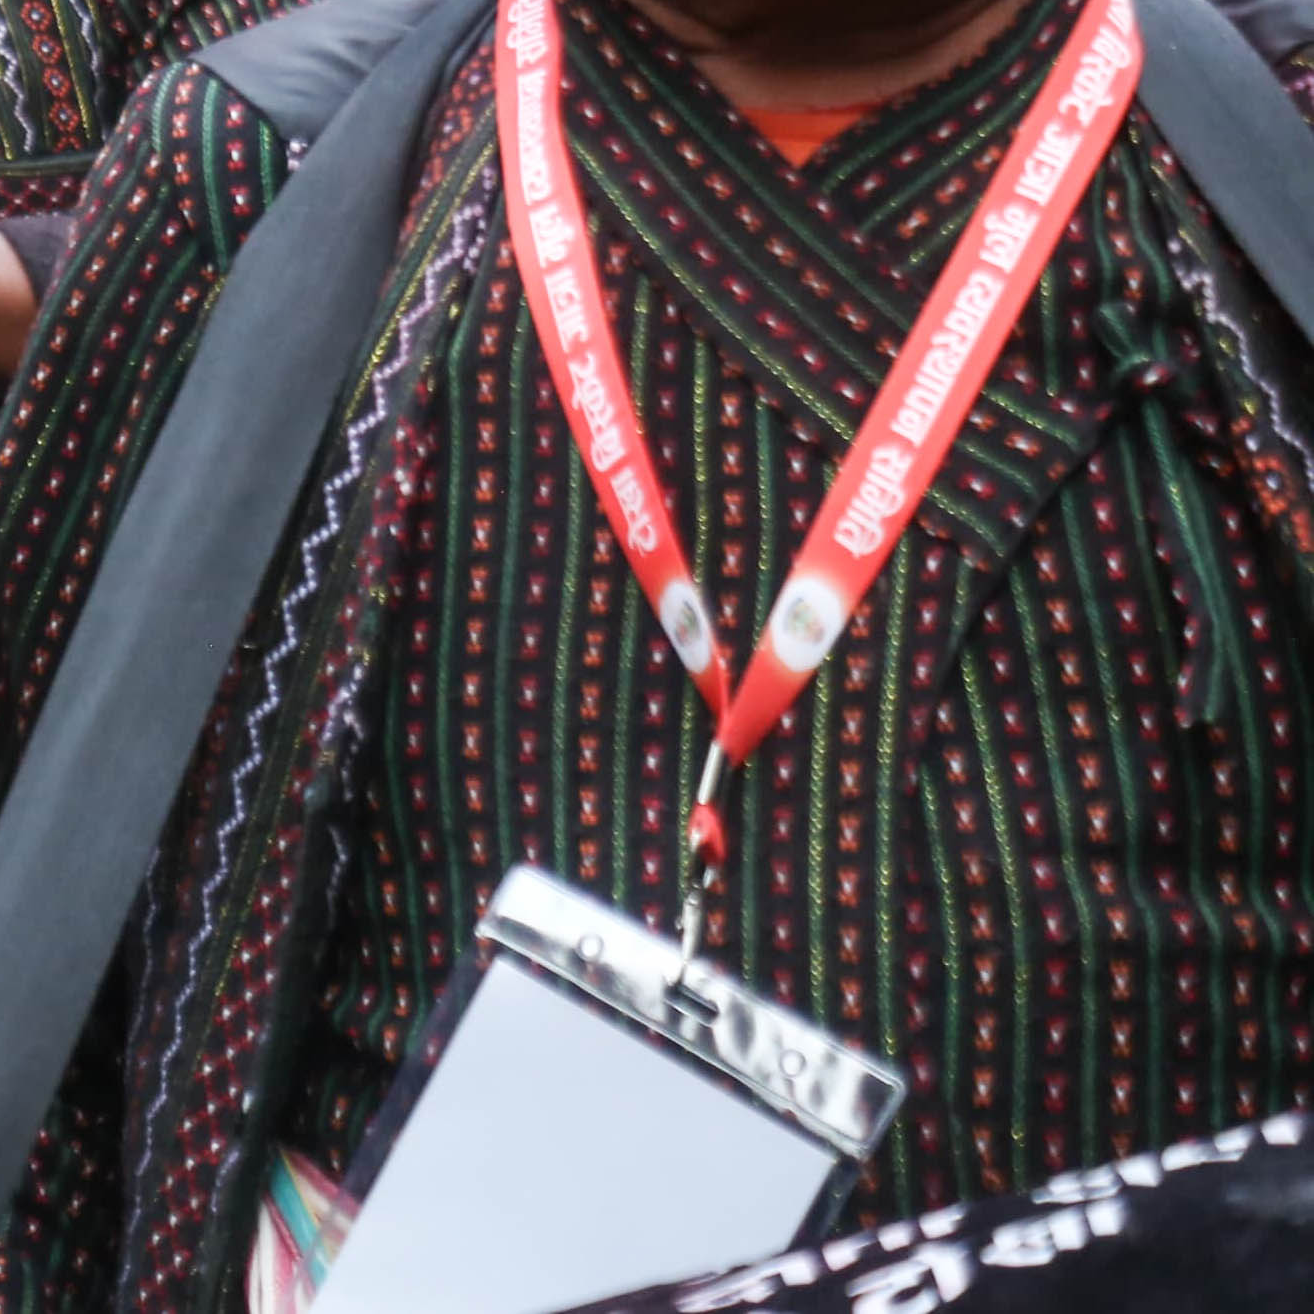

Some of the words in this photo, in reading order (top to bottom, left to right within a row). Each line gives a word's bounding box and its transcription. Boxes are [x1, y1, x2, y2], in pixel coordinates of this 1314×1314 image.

[1014, 120, 1083, 208] जात्रा
[543, 266, 588, 354] जात्रा
[890, 270, 1006, 449] व्यवस्थापन
[610, 466, 658, 557] टोखा
[832, 444, 915, 559] समिति
